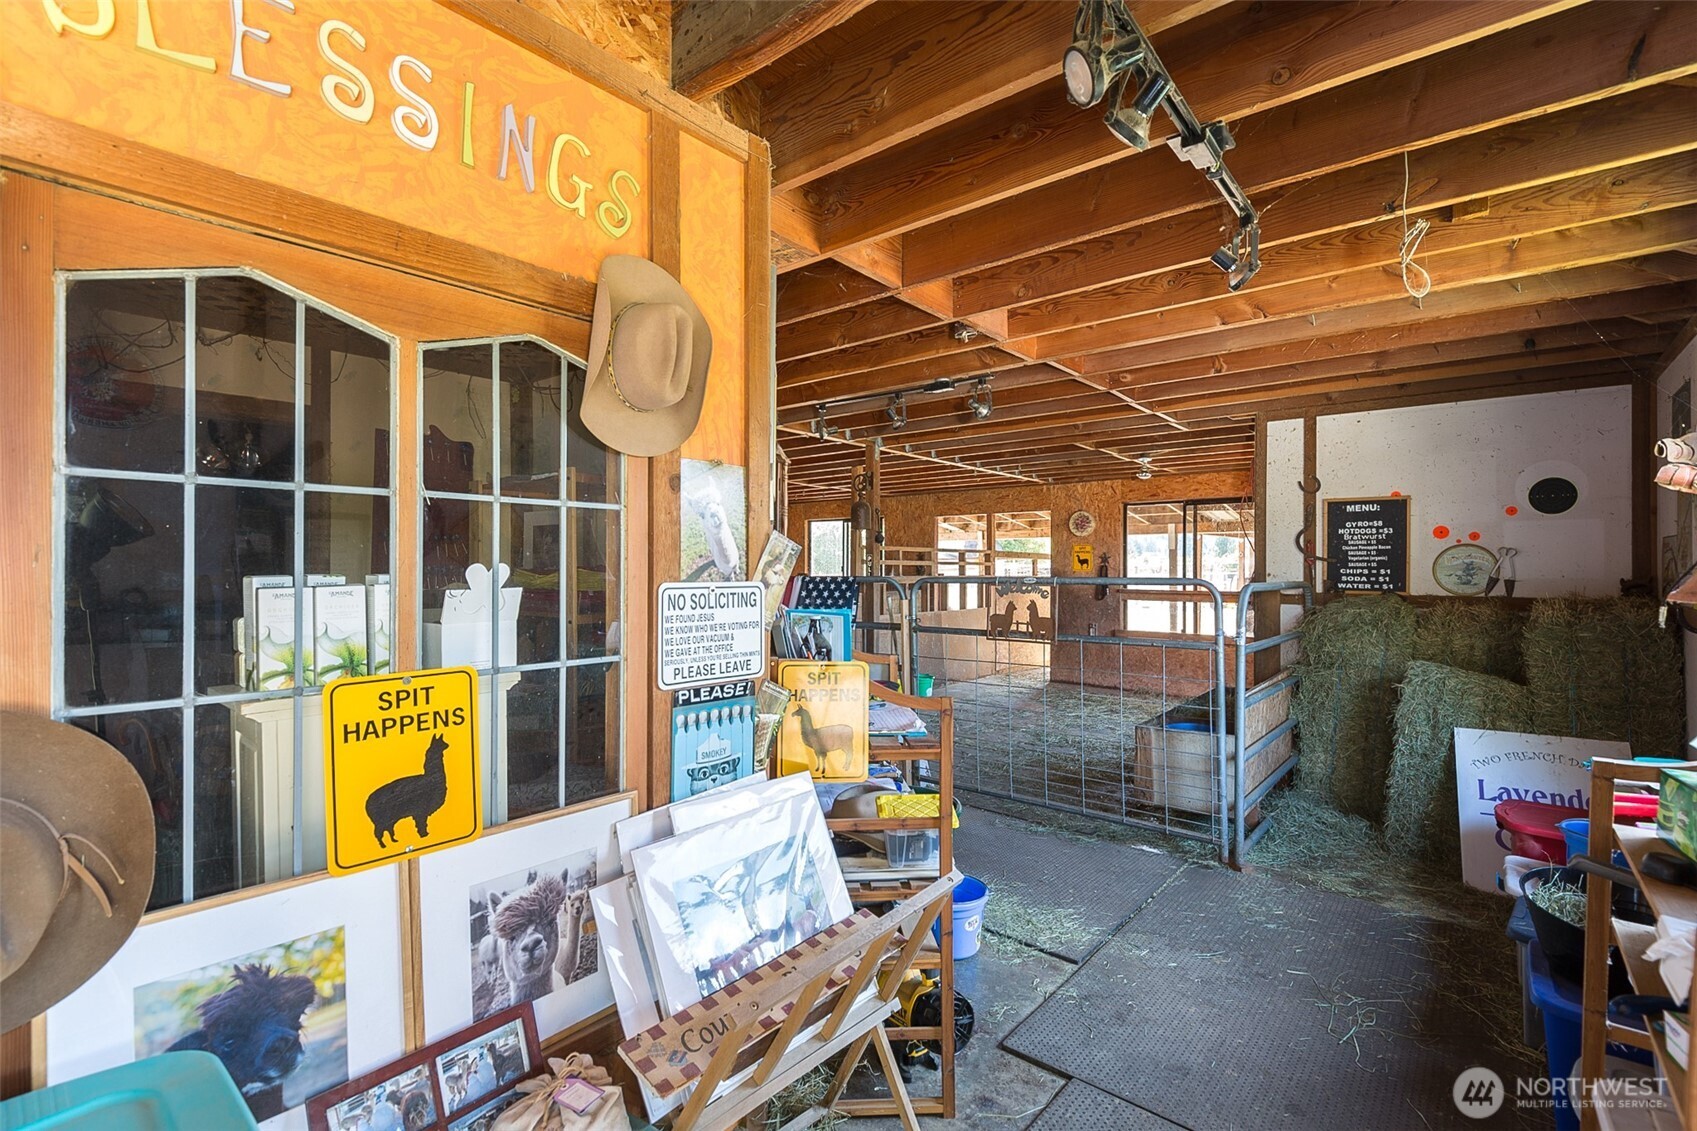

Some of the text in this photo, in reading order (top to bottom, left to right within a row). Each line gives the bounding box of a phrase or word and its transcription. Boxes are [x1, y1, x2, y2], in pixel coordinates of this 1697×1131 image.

[1346, 504, 1381, 512] MENU:
[1343, 533, 1387, 541] Bratwurst
[667, 591, 757, 611] NO SOLICITING
[664, 613, 715, 624] WE FOUND JESUS
[664, 620, 760, 635] WE KNOW WHO WE'RE VOTING FOR
[664, 633, 735, 647] WE LOVE OUR VACUUM &
[664, 643, 734, 658] WE GAVE AT THE OFFICE
[690, 656, 707, 664] UNLESS
[707, 654, 722, 662] YOU'RE
[722, 652, 739, 660] SELLING
[673, 659, 752, 680] PLEASE LEAVE
[807, 671, 841, 686] SPIT
[378, 686, 435, 711] SPIT
[678, 681, 752, 704] PLEASE!
[790, 688, 861, 703] HAPPENS
[343, 707, 466, 744] HAPPENS
[701, 747, 728, 760] SMOKEY
[1470, 754, 1501, 770] TWO
[1504, 751, 1564, 764] FRENCH
